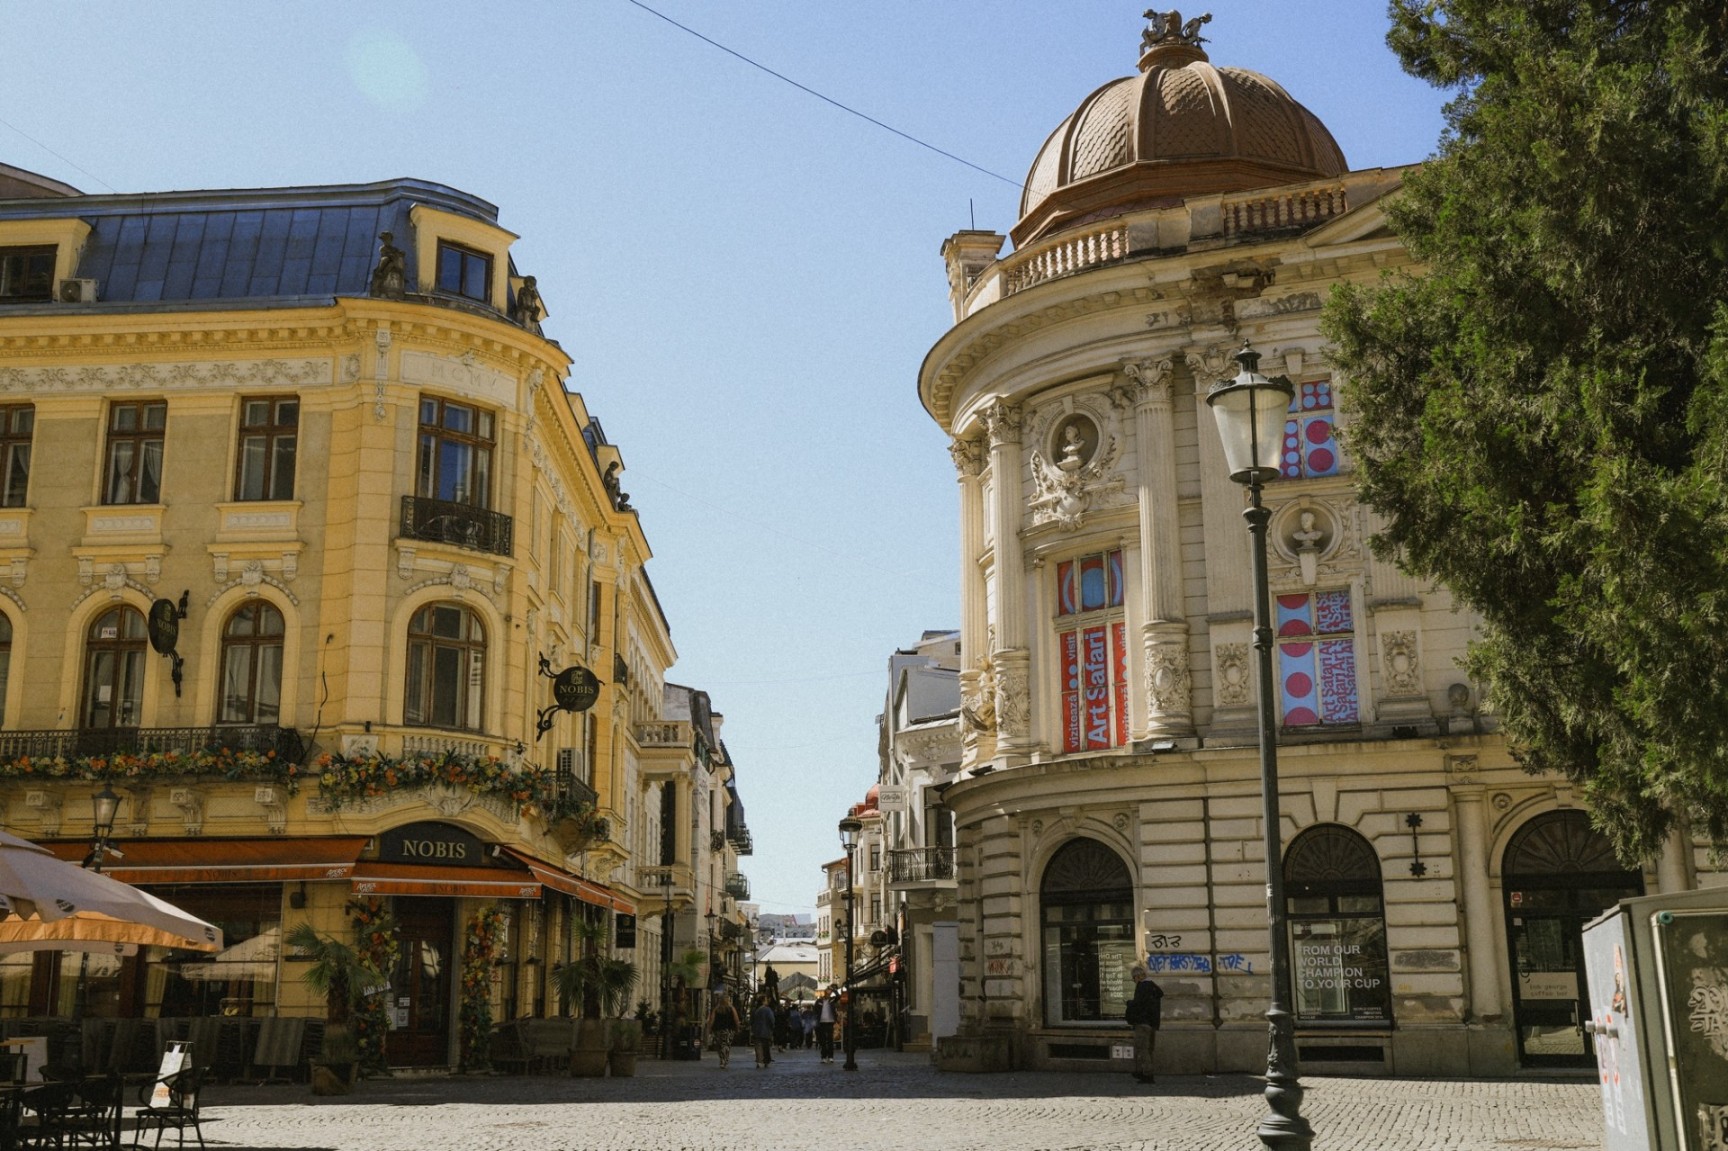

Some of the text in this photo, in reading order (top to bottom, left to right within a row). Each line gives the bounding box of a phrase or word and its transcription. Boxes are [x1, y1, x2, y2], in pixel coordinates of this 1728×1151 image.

[1332, 649, 1344, 671] Art
[1320, 658, 1334, 697] Safari
[1344, 656, 1357, 696] Safari
[560, 685, 594, 694] NOBIS
[1067, 635, 1079, 748] vizitează visit
[1085, 631, 1108, 744] Art Safari
[1334, 673, 1347, 713] Safari
[1322, 700, 1335, 722] Art
[402, 839, 466, 859] NOBIS
[438, 884, 467, 893] NOBIS
[1333, 945, 1361, 955] OUR
[1298, 967, 1363, 977] CHAMPION
[1300, 978, 1381, 989] TO YOUR CUP
